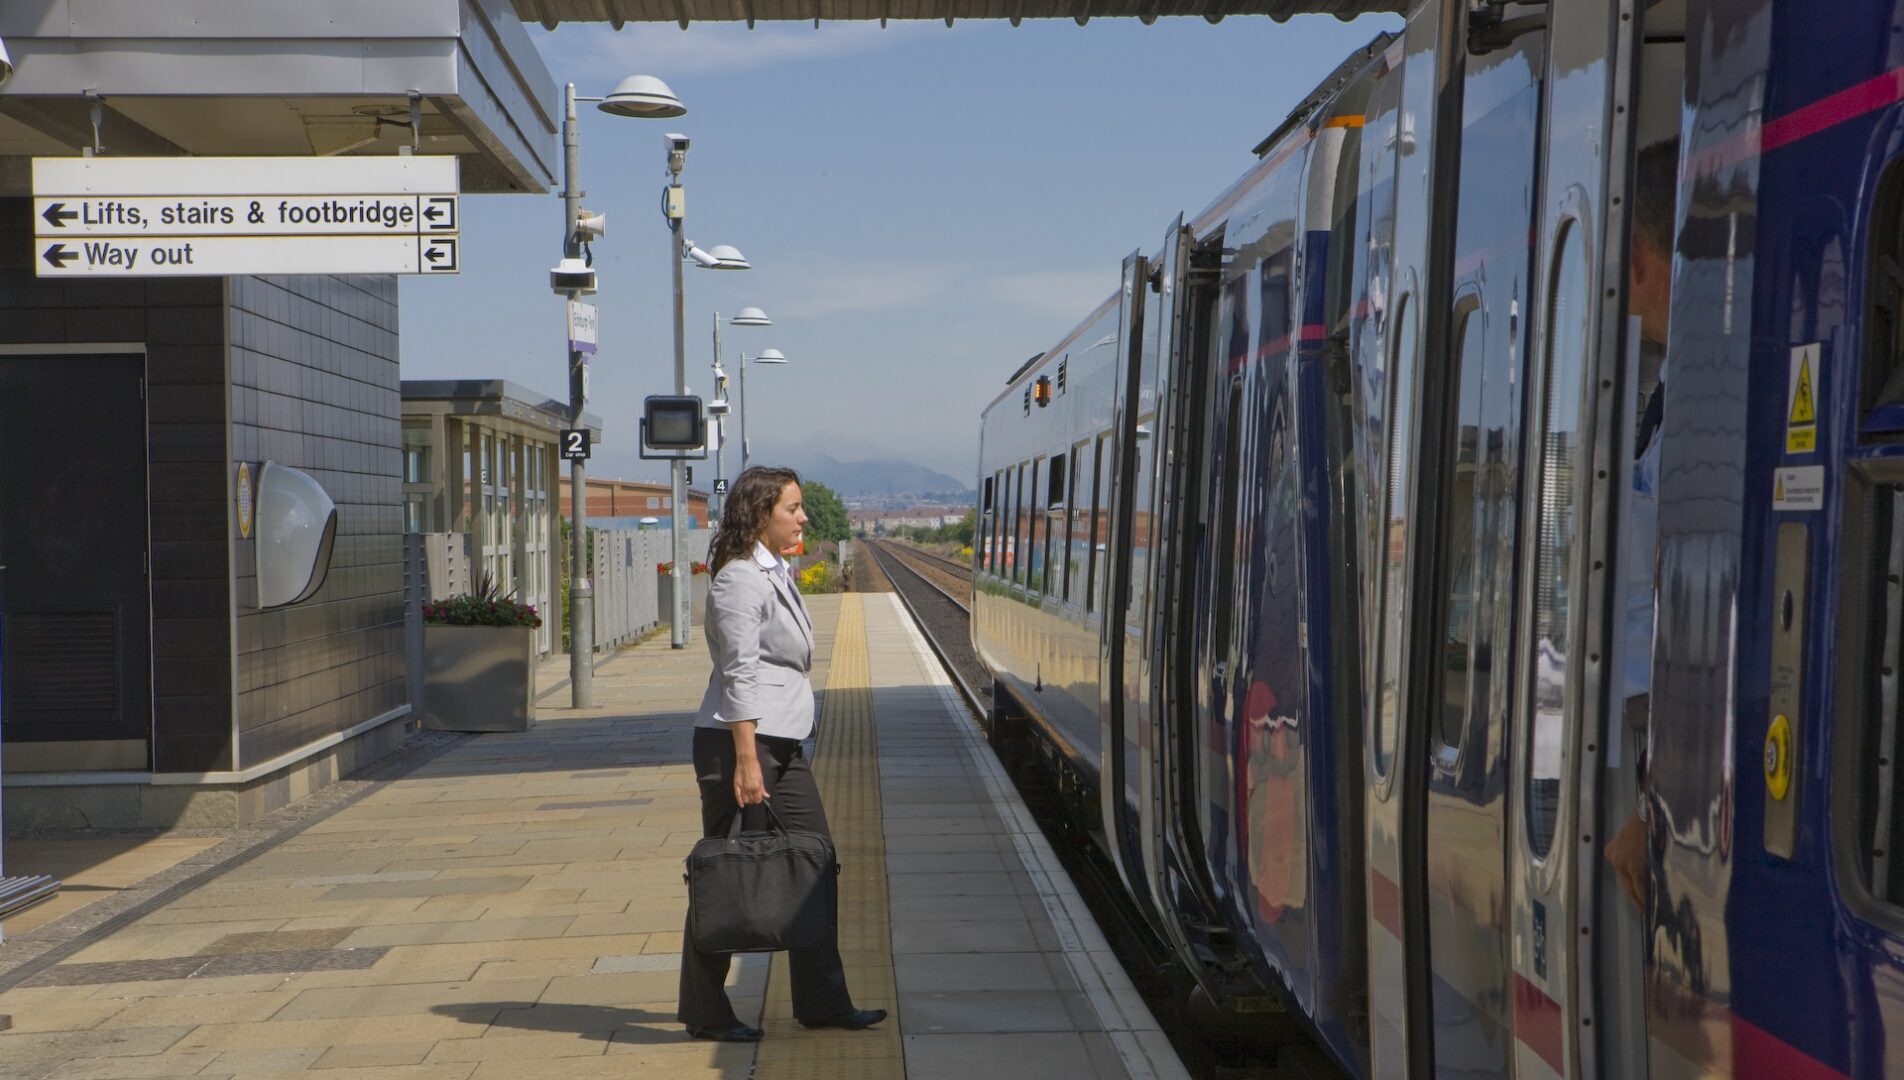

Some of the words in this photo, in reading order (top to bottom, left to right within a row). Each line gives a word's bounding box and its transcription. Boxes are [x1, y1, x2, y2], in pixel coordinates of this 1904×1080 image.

[83, 202, 148, 229] Lifts,
[161, 201, 234, 224] stairs
[247, 201, 265, 224] &
[278, 200, 414, 228] footbridge
[84, 242, 139, 269] Way
[151, 243, 194, 265] out
[568, 432, 583, 452] 2
[716, 480, 726, 491] 4
